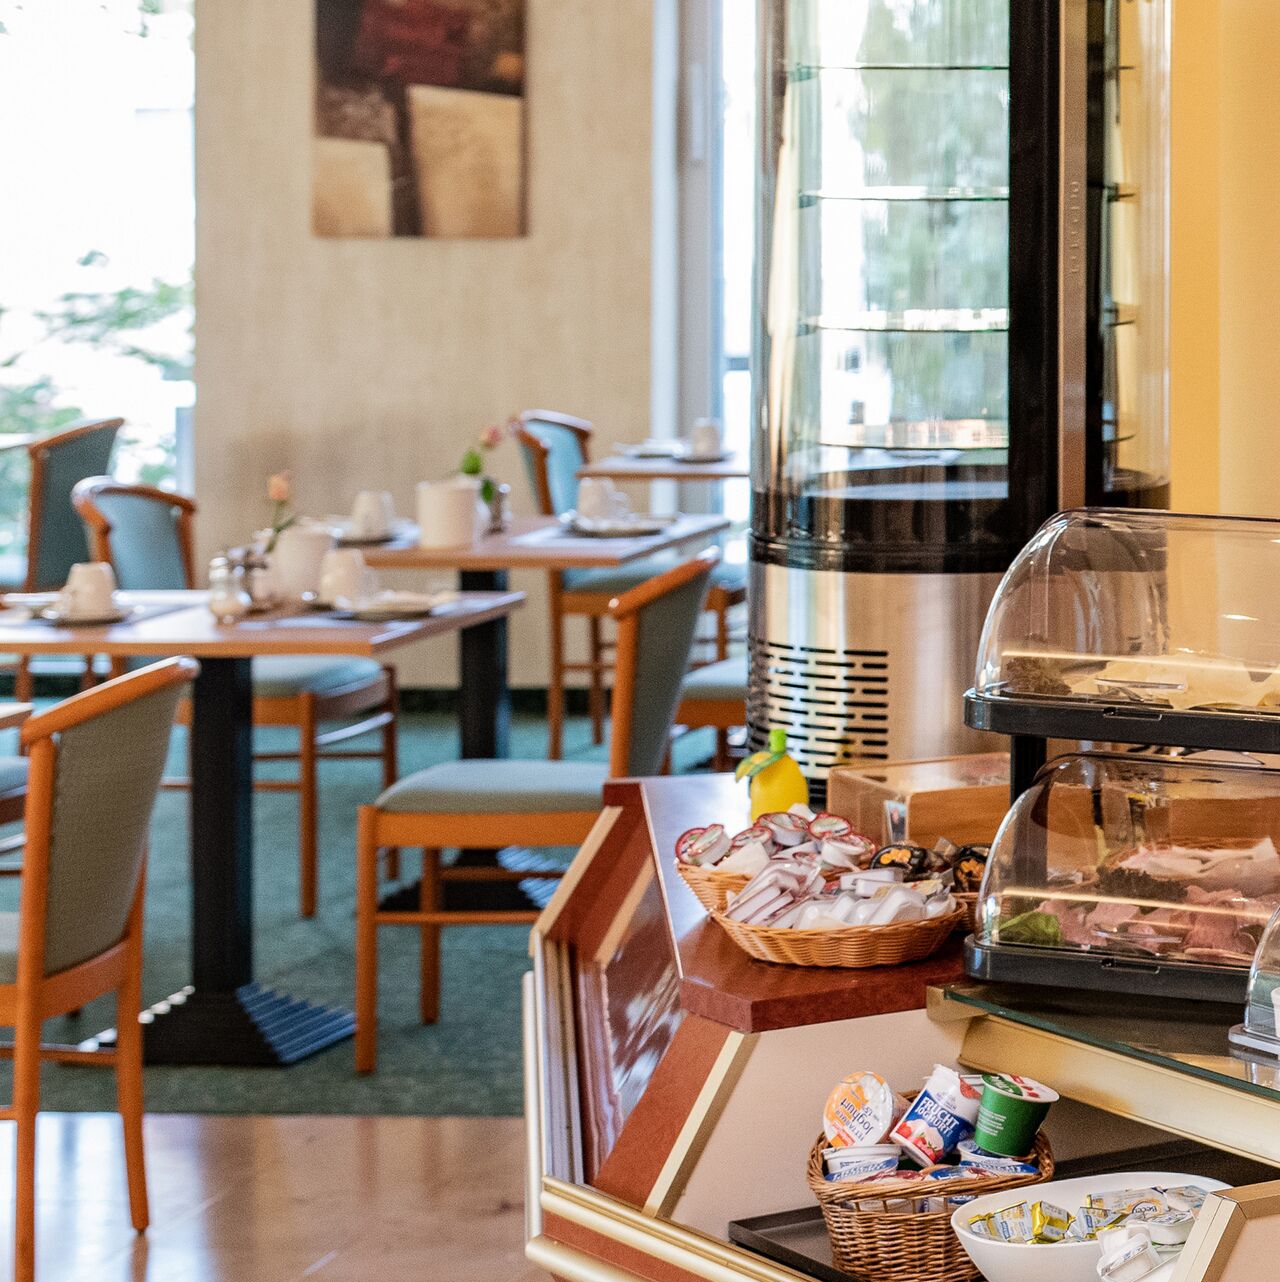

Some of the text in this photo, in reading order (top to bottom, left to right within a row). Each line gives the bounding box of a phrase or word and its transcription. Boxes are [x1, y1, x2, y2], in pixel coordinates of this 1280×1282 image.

[841, 1098, 873, 1135] Joghurt
[914, 1105, 951, 1134] JOGHURT
[919, 1096, 959, 1129] FRUCHT
